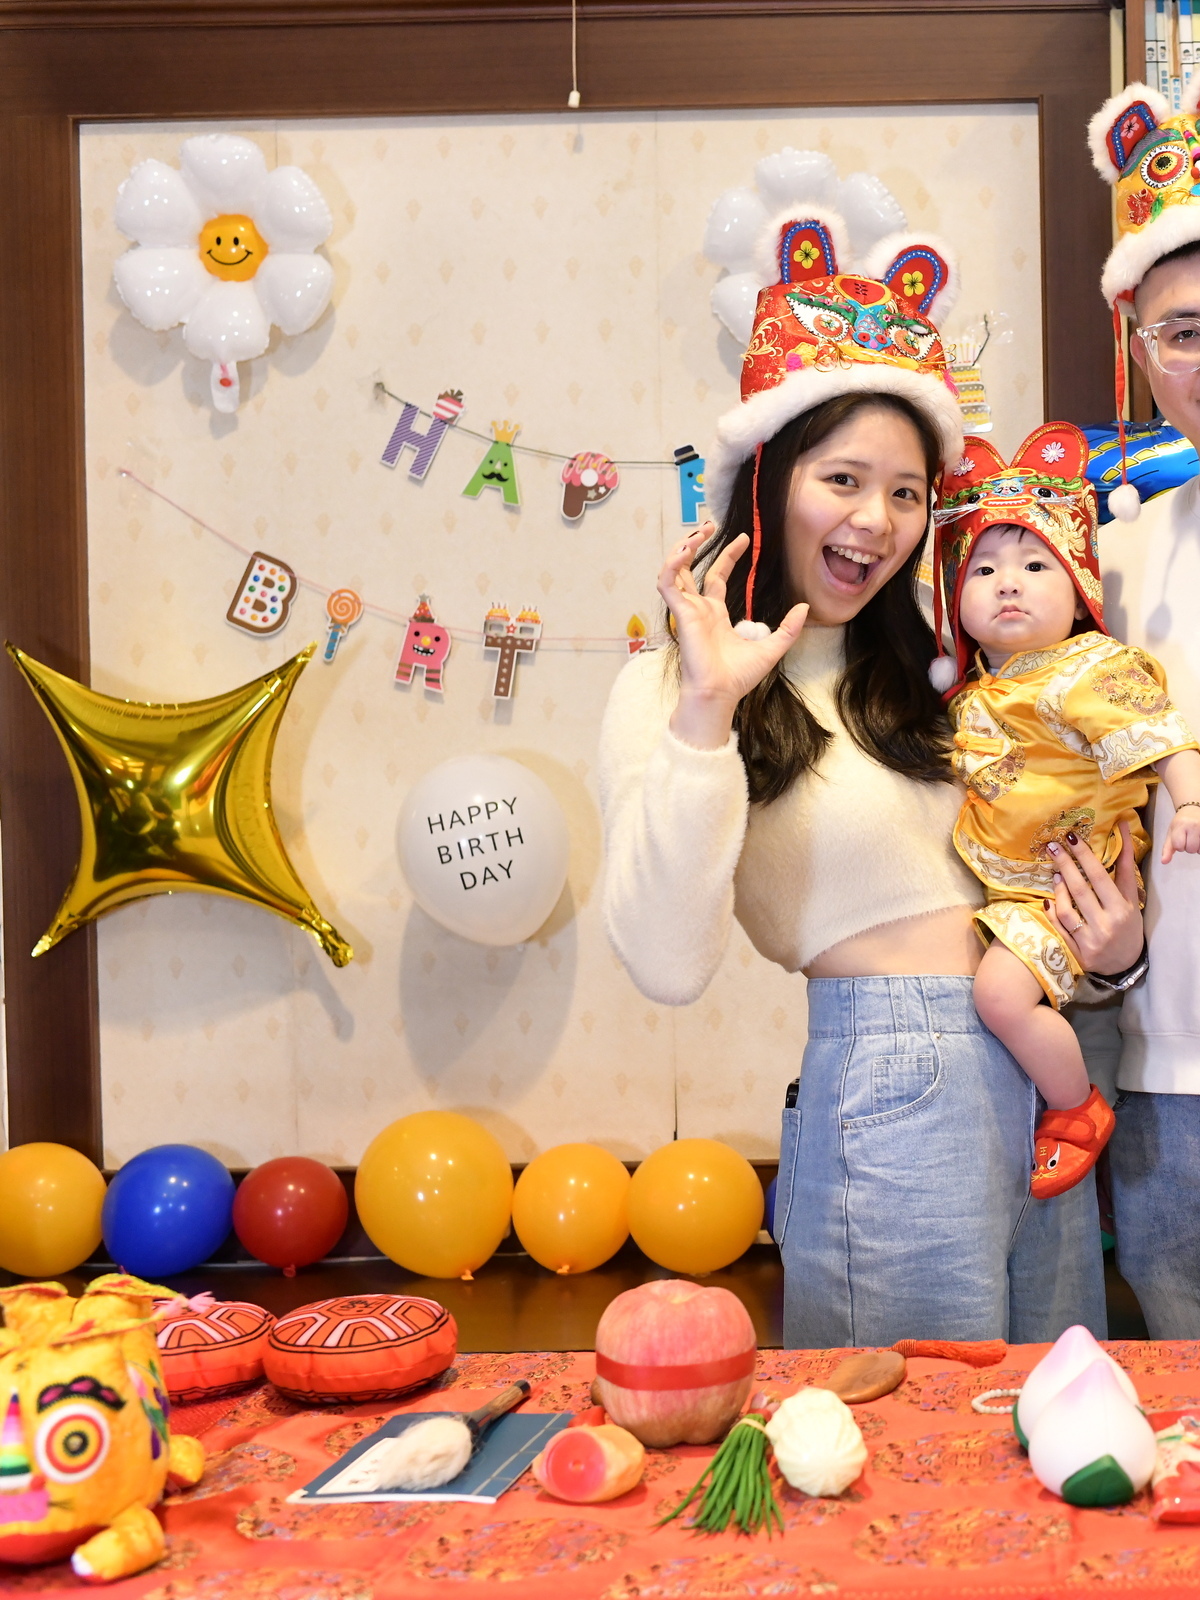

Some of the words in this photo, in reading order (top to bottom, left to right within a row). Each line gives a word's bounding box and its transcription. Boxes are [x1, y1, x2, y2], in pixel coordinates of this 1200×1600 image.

[427, 797, 517, 835] HAPPY
[437, 827, 524, 865] BIRTH
[459, 860, 514, 891] DAY
